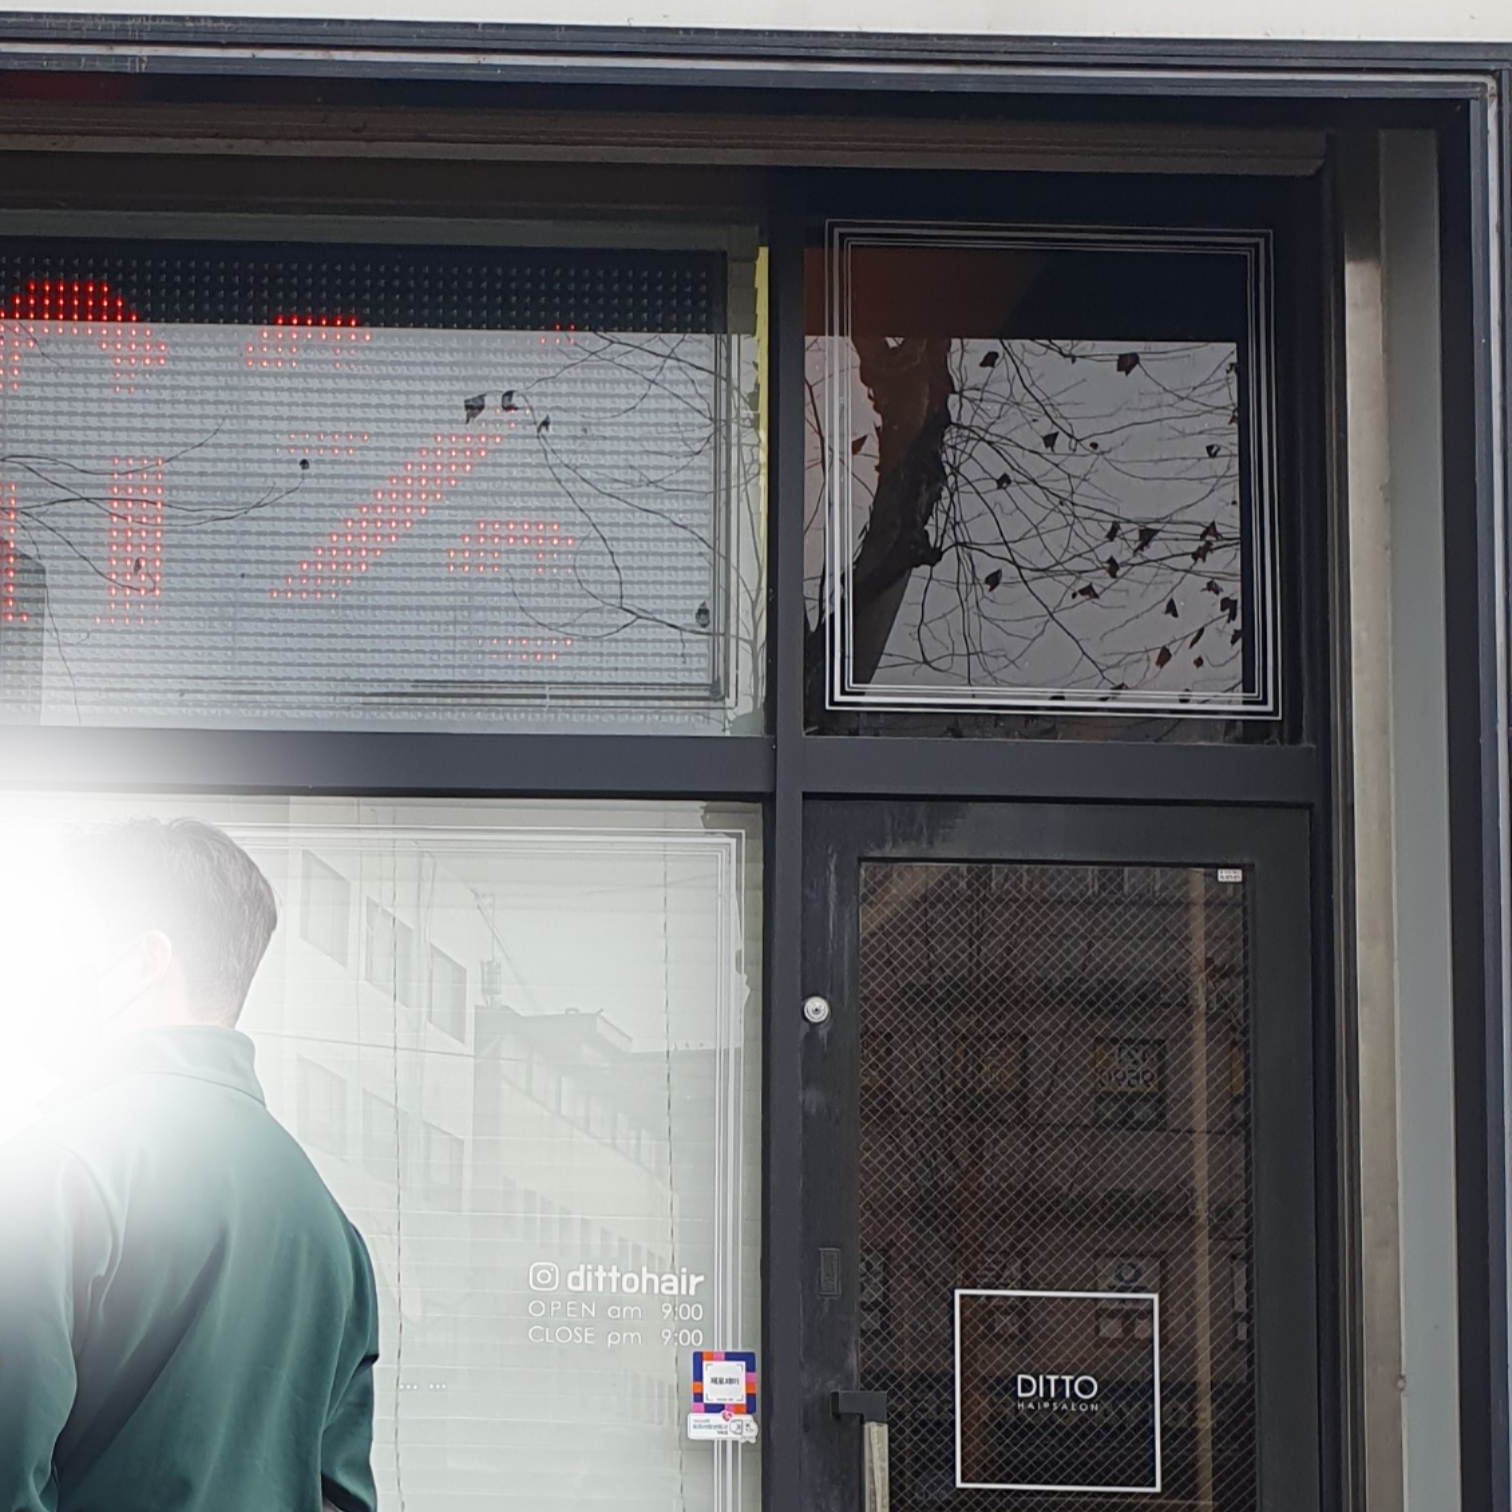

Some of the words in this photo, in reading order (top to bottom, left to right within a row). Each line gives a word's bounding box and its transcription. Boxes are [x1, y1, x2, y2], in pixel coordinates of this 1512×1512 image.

[567, 1264, 704, 1296] dittohair
[528, 1300, 596, 1318] OPEN
[607, 1304, 642, 1319] am
[661, 1303, 703, 1321] 9:00
[528, 1325, 595, 1344] CLOSE
[607, 1330, 642, 1348] pm
[661, 1329, 703, 1346] 9:00
[1016, 1373, 1098, 1399] DITTO
